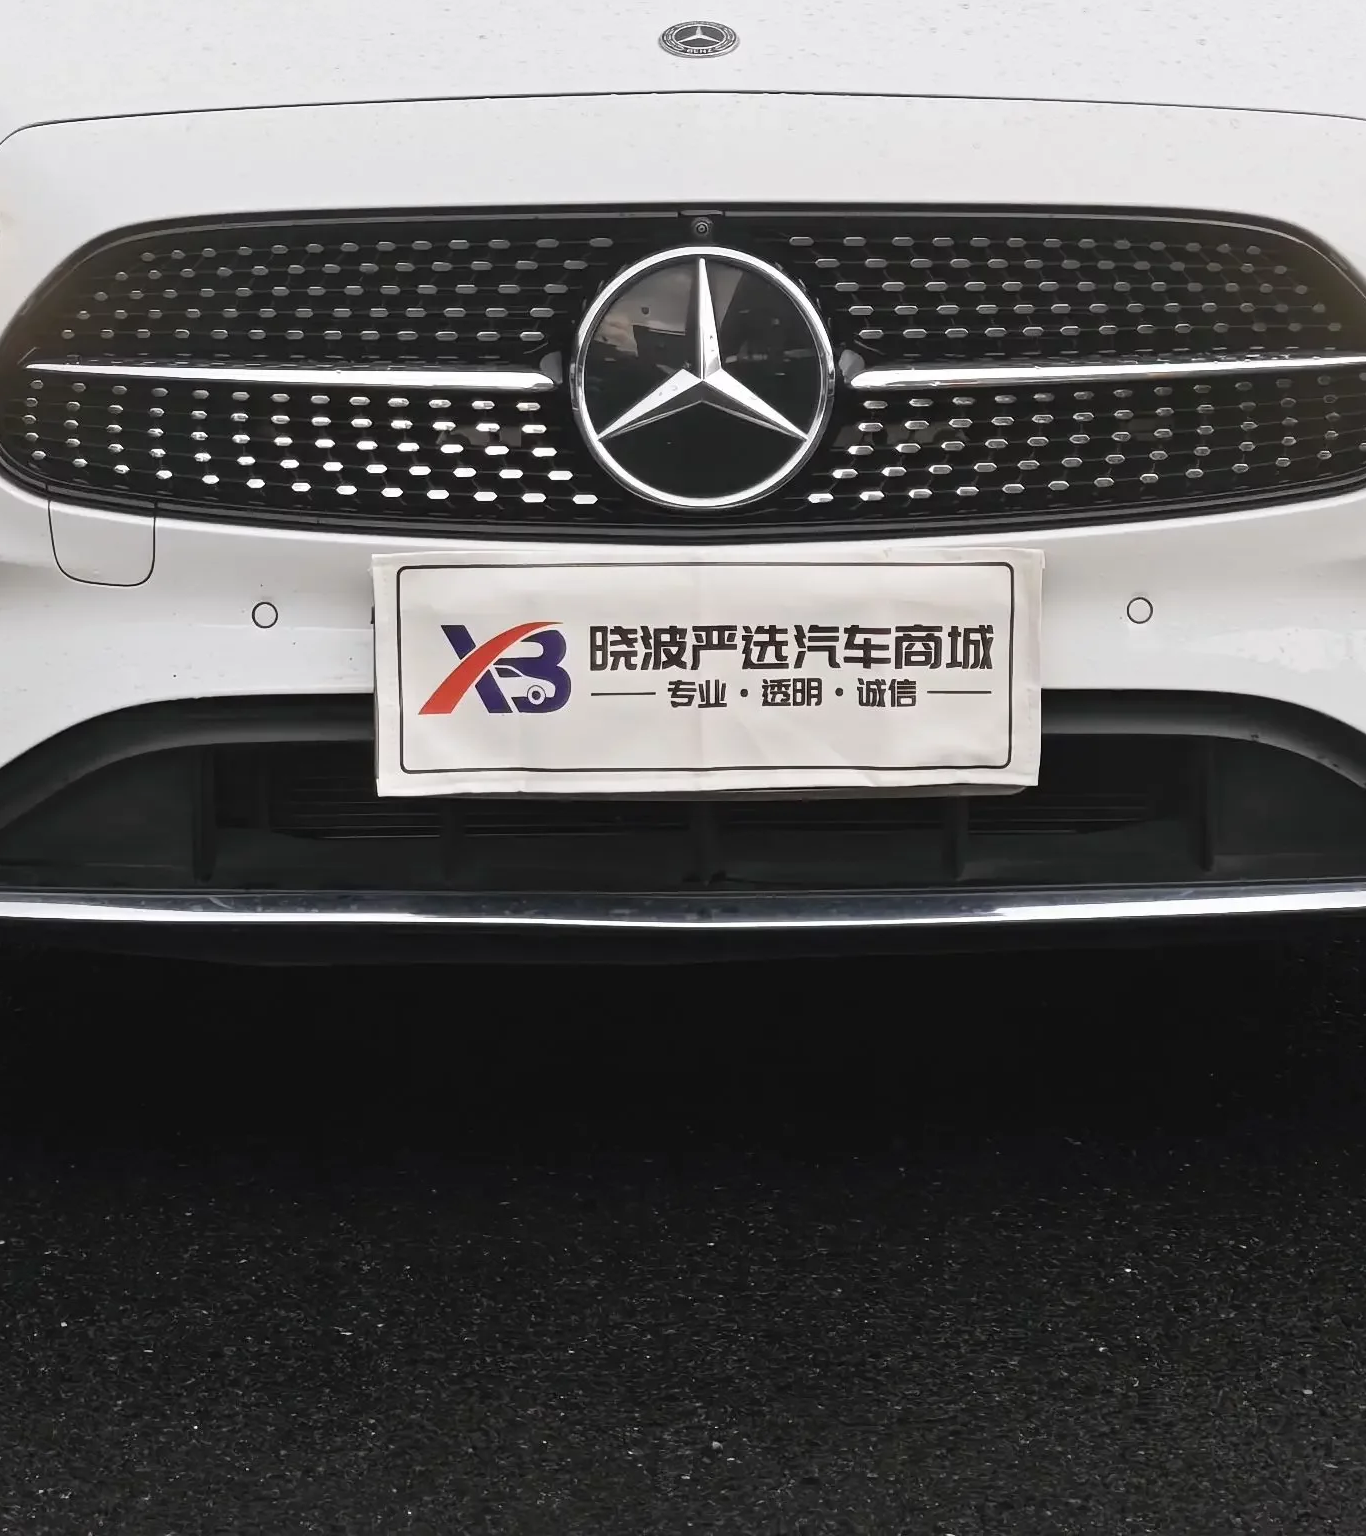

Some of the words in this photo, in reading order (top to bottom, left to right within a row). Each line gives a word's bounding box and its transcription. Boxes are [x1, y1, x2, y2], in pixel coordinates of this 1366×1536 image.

[590, 624, 993, 670] 晓波严选汽车商城
